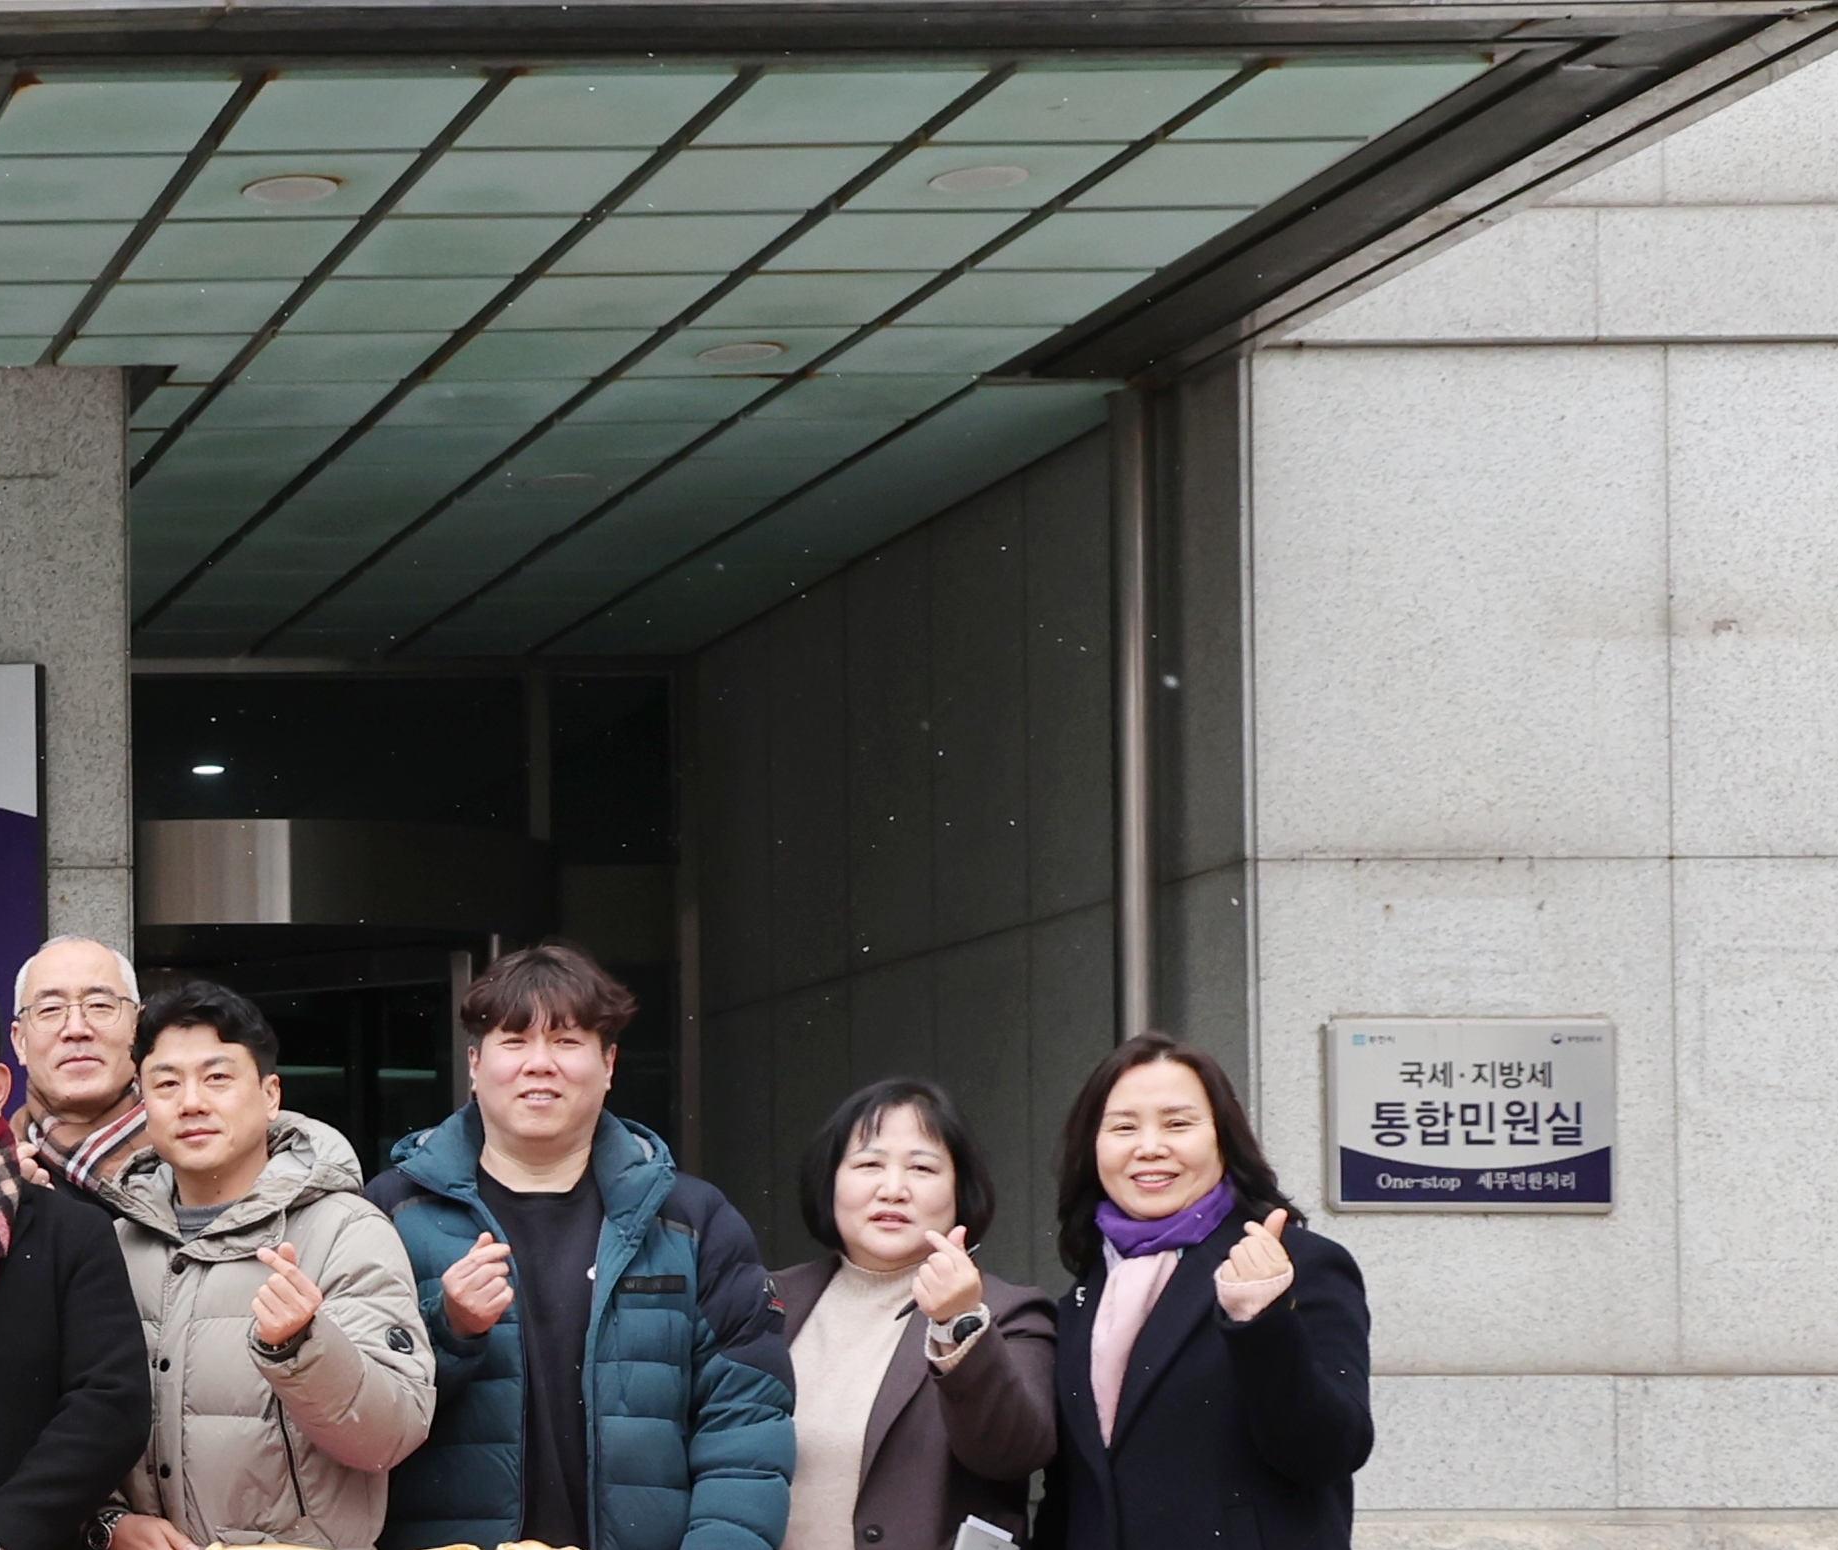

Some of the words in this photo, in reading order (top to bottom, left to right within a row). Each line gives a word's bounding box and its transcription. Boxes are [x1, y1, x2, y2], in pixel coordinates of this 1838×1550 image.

[1371, 1101, 1584, 1148] 통합민원실
[1376, 1172, 1462, 1191] One-stop
[1476, 1171, 1577, 1191] 세무민원처리
